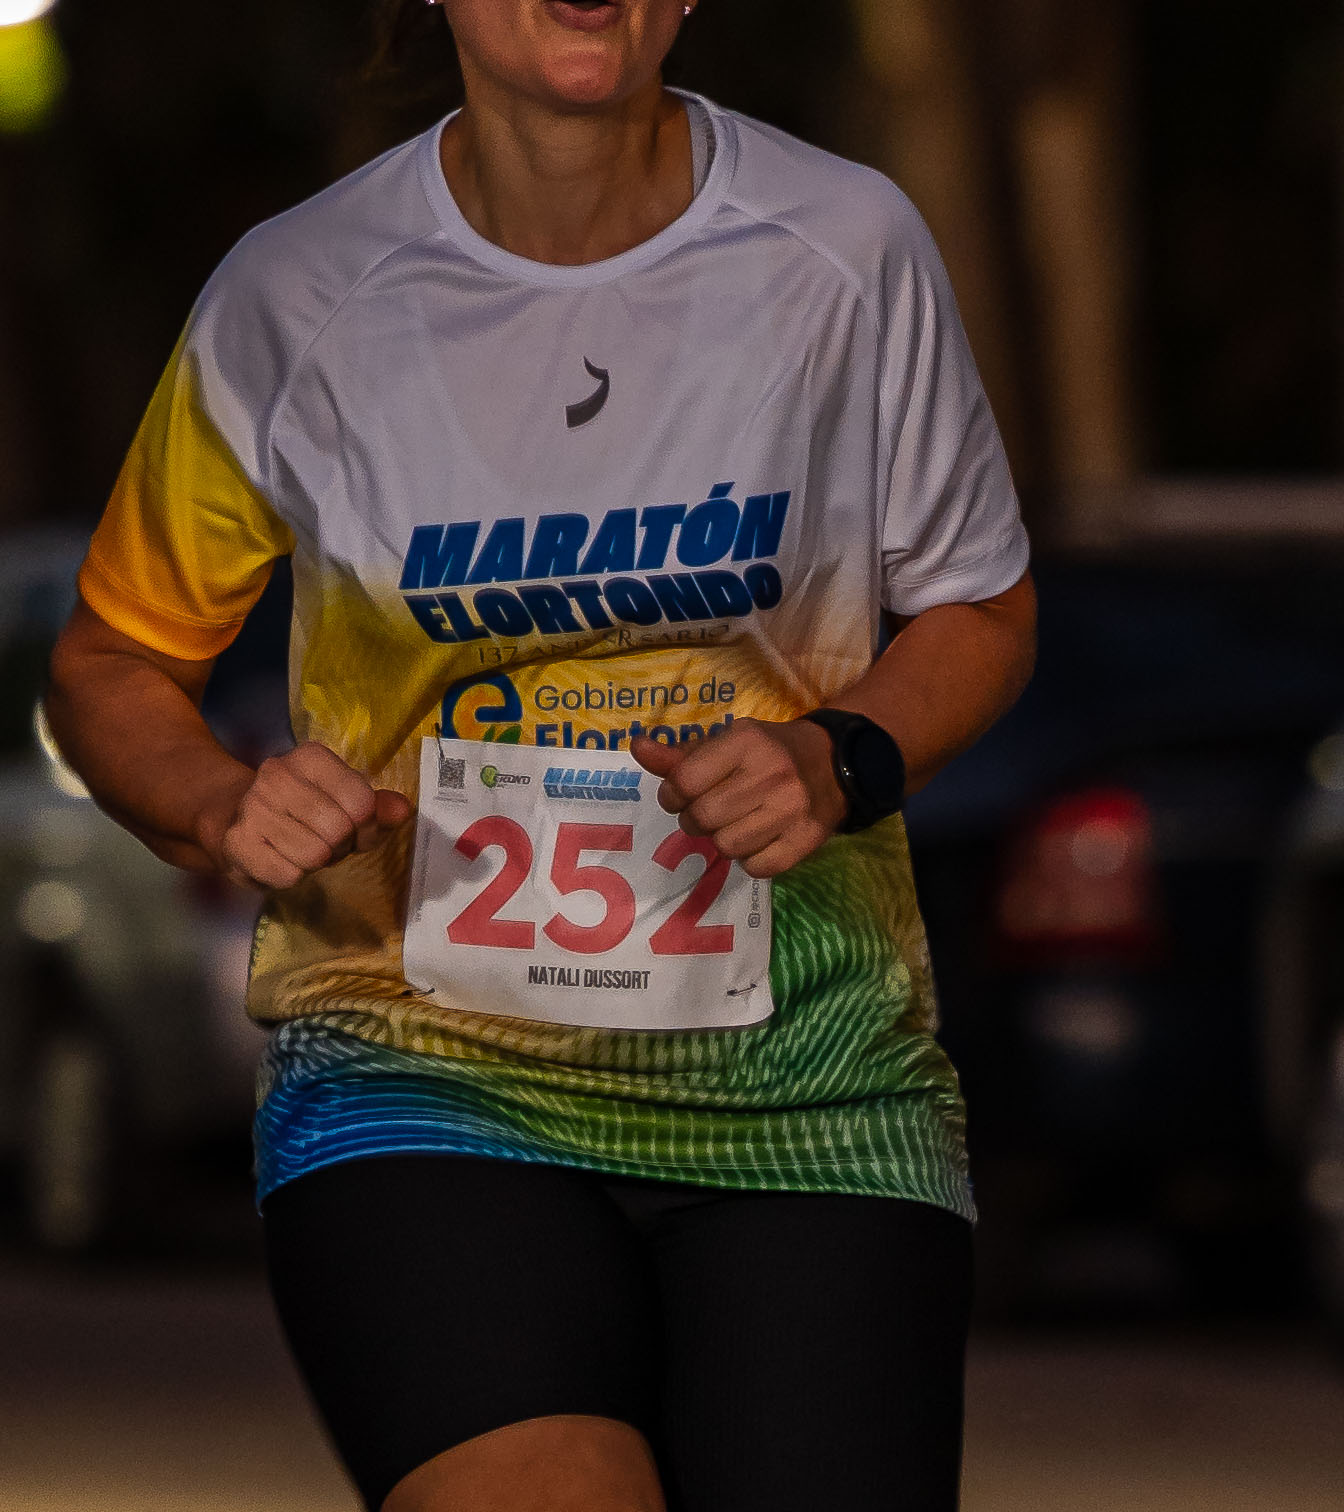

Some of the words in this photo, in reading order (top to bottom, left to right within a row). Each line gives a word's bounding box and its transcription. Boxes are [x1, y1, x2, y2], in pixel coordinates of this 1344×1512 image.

[399, 481, 792, 590] MARATÓN
[402, 562, 783, 644] ELORTONDO
[534, 681, 689, 711] Gobierno
[698, 676, 737, 704] de
[447, 815, 735, 955] 252
[528, 965, 580, 987] NATALI
[583, 968, 651, 990] DUSSORT
